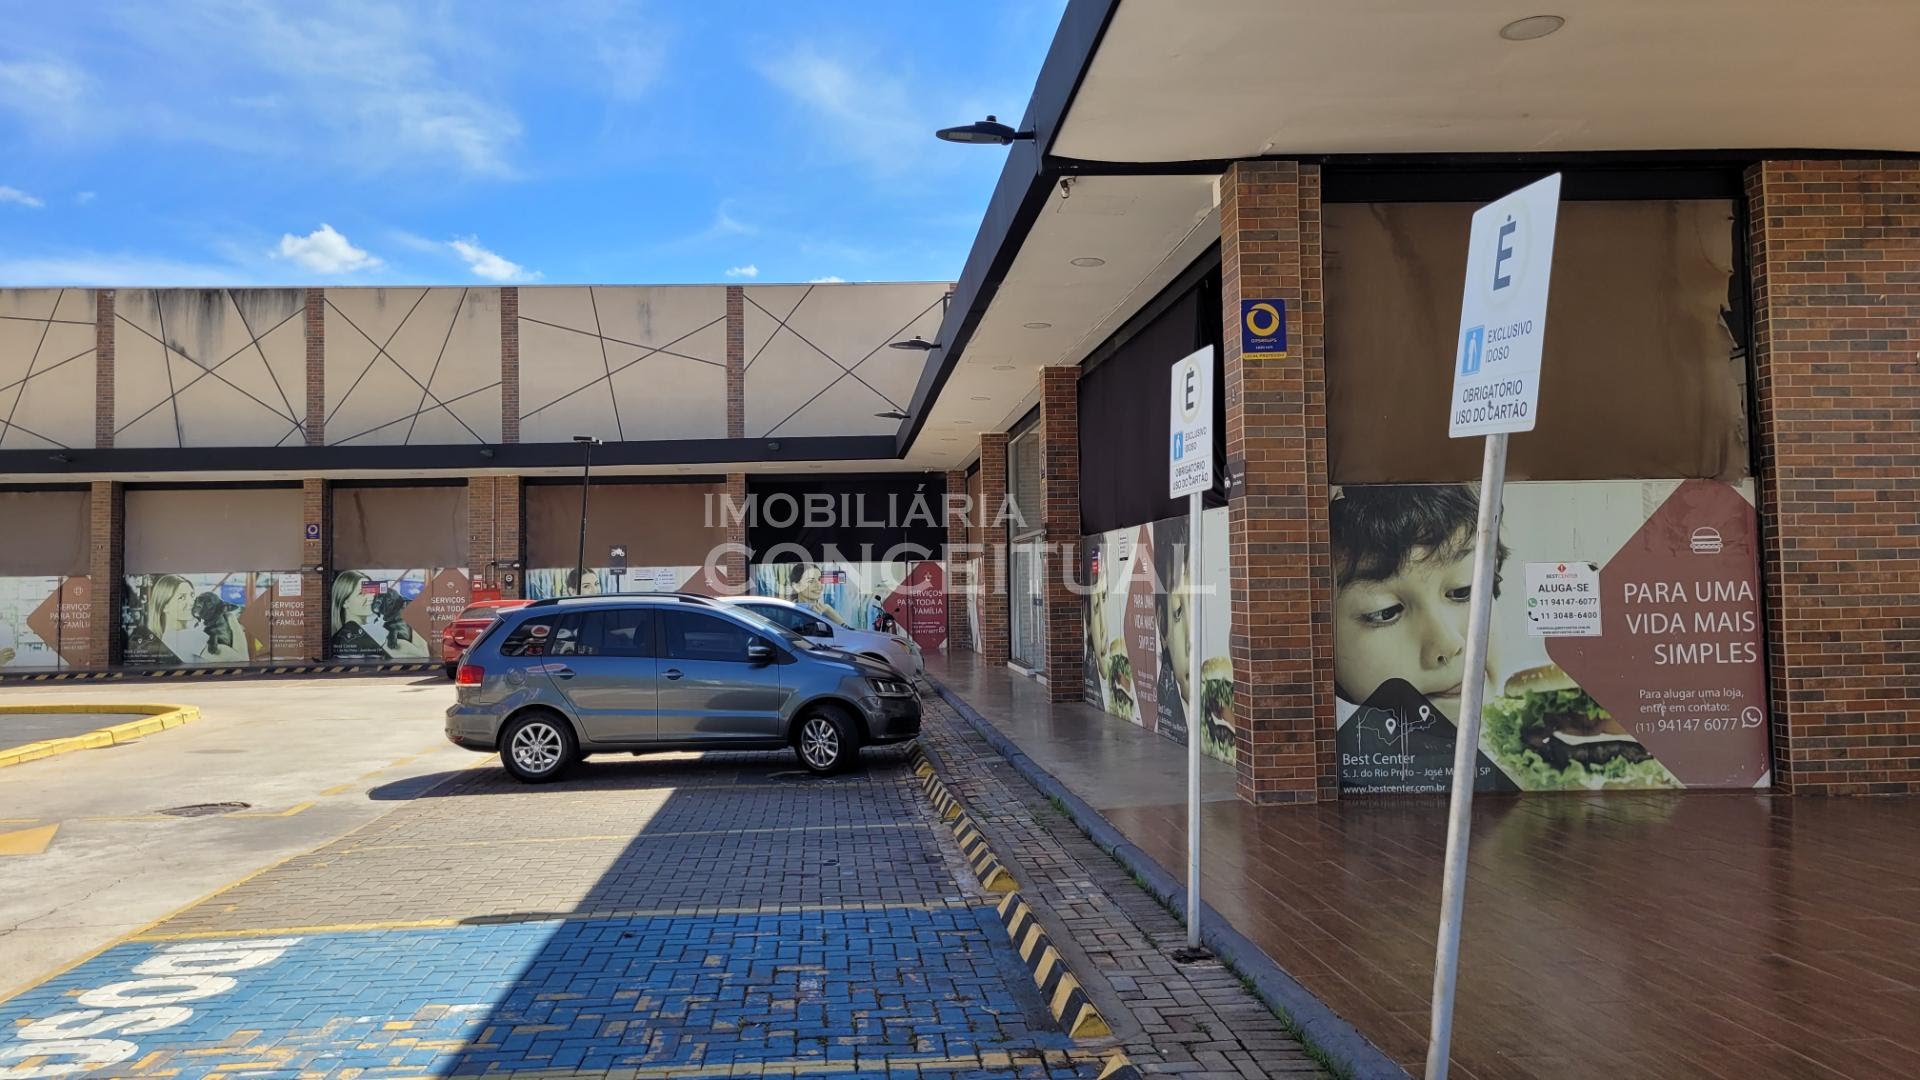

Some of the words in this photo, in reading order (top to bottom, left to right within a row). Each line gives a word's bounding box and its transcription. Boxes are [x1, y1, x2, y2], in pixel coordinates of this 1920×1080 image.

[1487, 320, 1533, 344] EXCLUSIVO
[1485, 345, 1510, 363] IDOSO
[1462, 378, 1523, 403] OBRIGATÓRIO
[1455, 408, 1472, 425] USO
[1473, 406, 1486, 422] DO
[1487, 400, 1528, 421] CARTÃO
[1538, 583, 1590, 593] ALUGA-SE
[1624, 582, 1688, 604] PARA
[1695, 580, 1754, 602] UMA
[1551, 597, 1597, 606] 94147-6077
[1541, 612, 1550, 620] 11
[1553, 611, 1598, 619] 3048-6400
[1625, 612, 1686, 634] VIDA
[1694, 611, 1755, 633] MAIS
[1654, 642, 1757, 665] SIMPLES
[1639, 689, 1662, 699] Para
[1663, 689, 1695, 701] alugar
[1698, 690, 1721, 698] uma
[1723, 688, 1744, 700] loja,
[1640, 703, 1667, 713] entre
[1669, 705, 1686, 713] em
[1688, 703, 1730, 712] contato:
[1635, 722, 1655, 734] (11)
[1658, 719, 1700, 732] 94147
[1704, 718, 1738, 731] 6077
[1342, 753, 1370, 766] Best
[1372, 752, 1416, 765] Center
[1343, 770, 1352, 778] S.
[1361, 768, 1373, 777] do
[1374, 768, 1389, 777] Rio
[1424, 767, 1443, 776] José
[1479, 767, 1491, 776] SP
[1343, 783, 1446, 794] www.bestcenter.com.br
